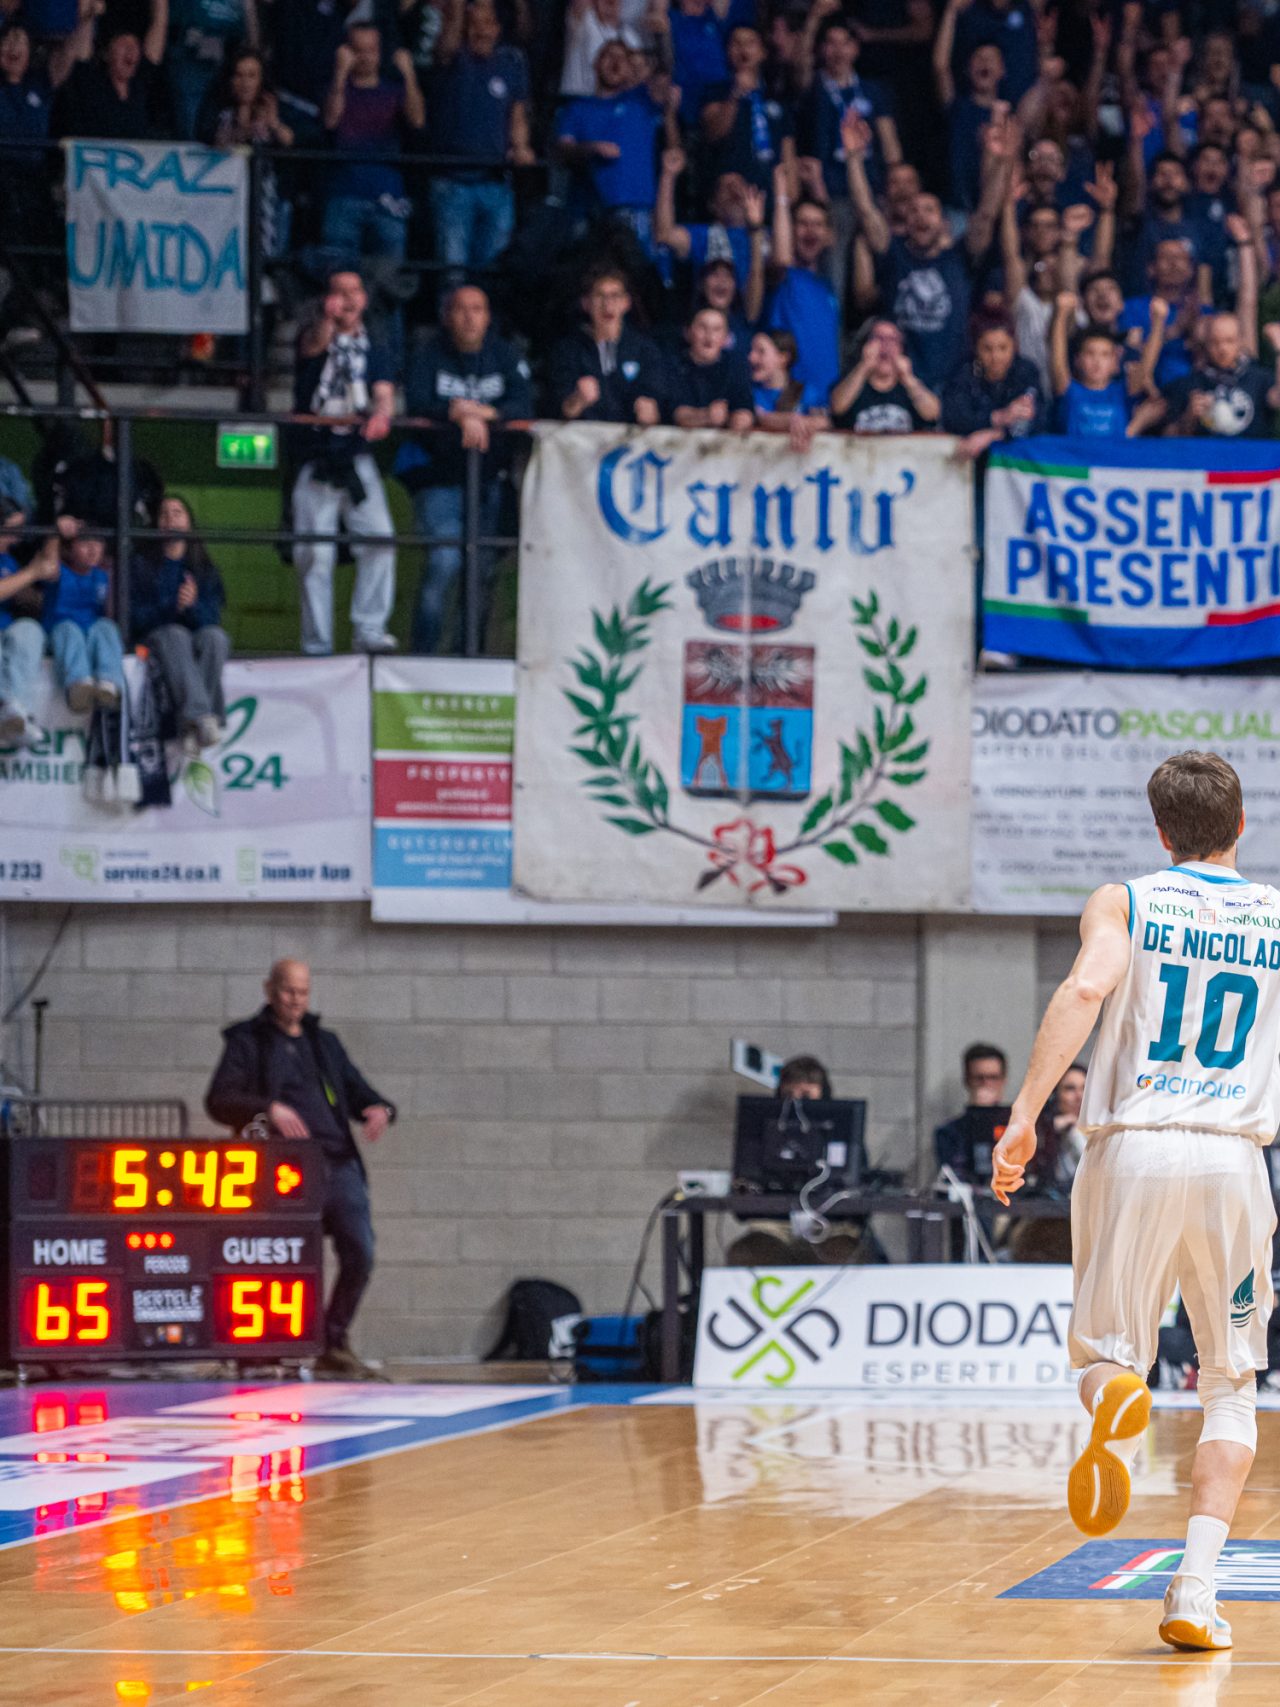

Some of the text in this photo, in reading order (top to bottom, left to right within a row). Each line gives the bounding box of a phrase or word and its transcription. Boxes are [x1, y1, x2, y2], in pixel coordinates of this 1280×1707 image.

[73, 144, 235, 195] FRAZ
[66, 218, 245, 294] UMIDA
[1024, 481, 1272, 548] ASSENTI
[222, 753, 288, 790] 24
[1149, 902, 1194, 920] INTESA
[1143, 920, 1280, 970] DE NICOLAO
[1147, 962, 1259, 1070] 10
[1153, 1073, 1246, 1100] acinque
[113, 1150, 258, 1208] 5:42
[33, 1239, 107, 1265] HOME
[222, 1237, 304, 1264] GUEST
[36, 1283, 110, 1341] 65
[231, 1281, 304, 1337] 54
[861, 1361, 1017, 1385] ESPERTI
